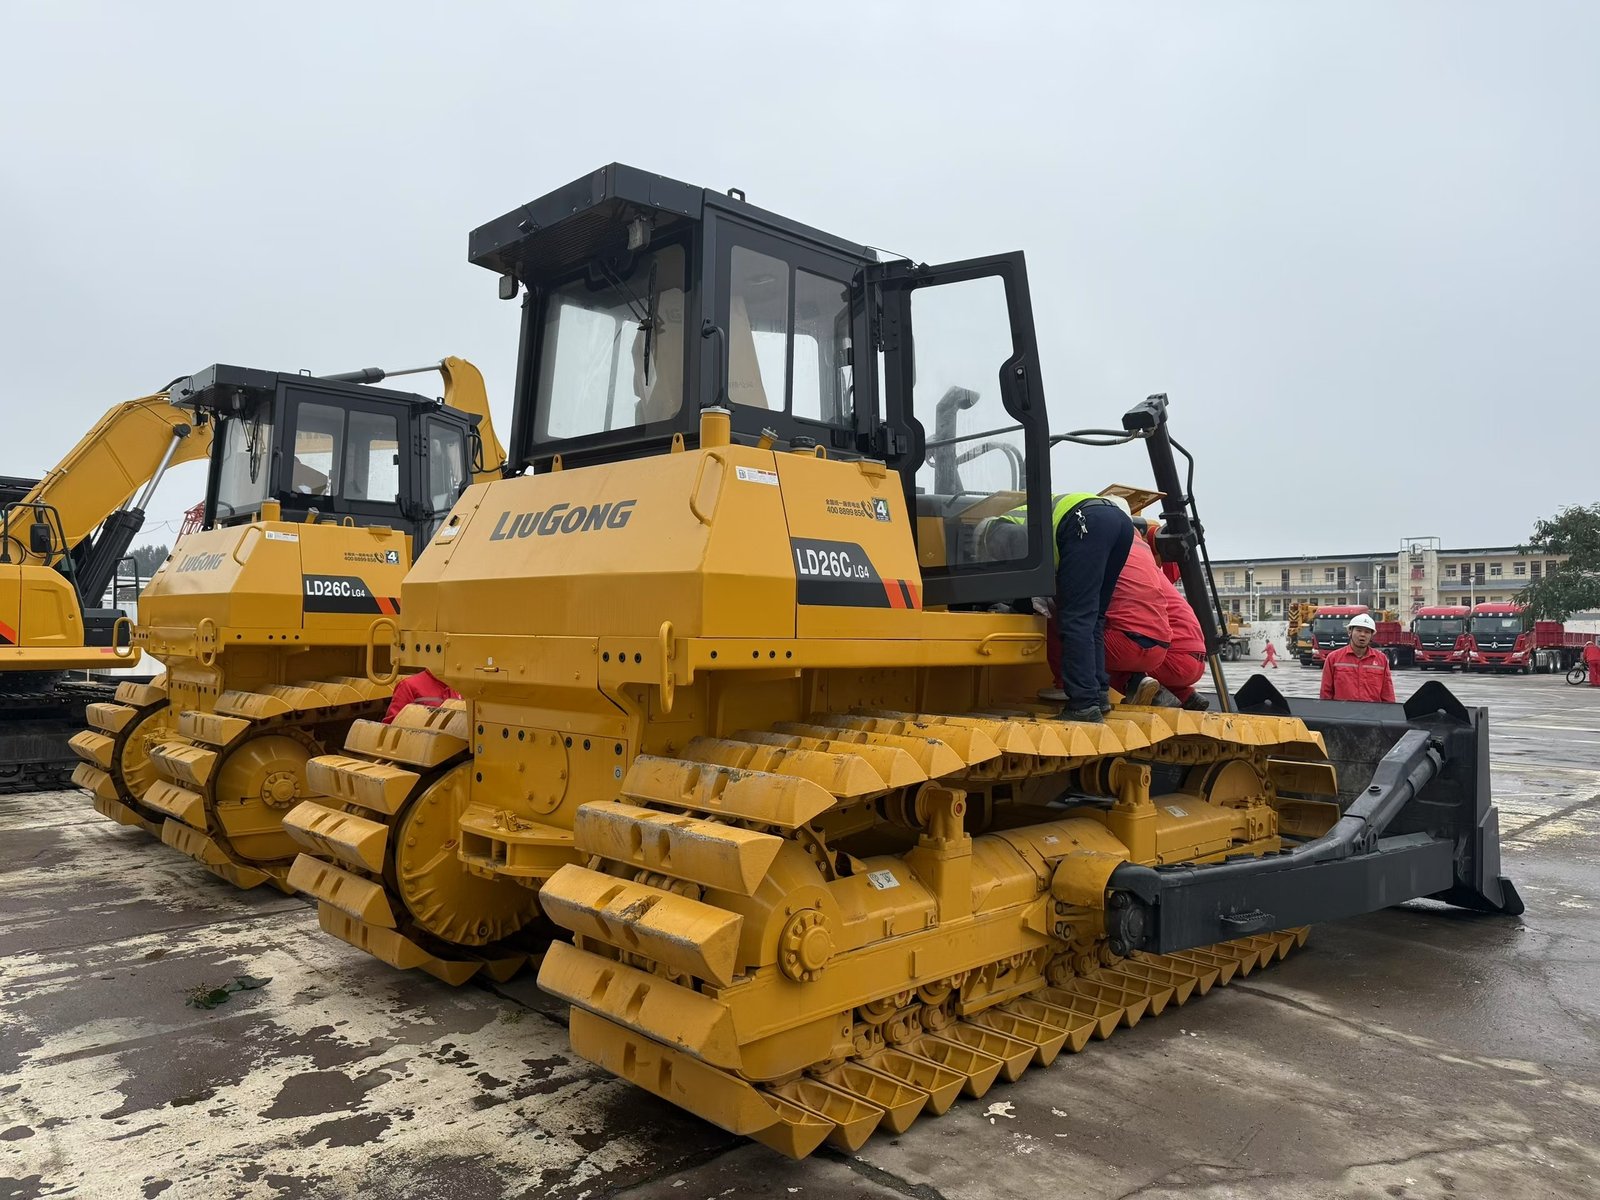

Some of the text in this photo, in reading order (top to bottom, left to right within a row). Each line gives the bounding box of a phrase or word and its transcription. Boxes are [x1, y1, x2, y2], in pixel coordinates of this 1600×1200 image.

[827, 506, 839, 515] 400
[876, 500, 887, 516] 4
[489, 500, 637, 541] LIUGONG
[176, 552, 227, 573] LIUGONG
[387, 551, 397, 561] 4
[796, 548, 870, 578] LD26C LG4
[306, 580, 366, 598] LD26C LG4
